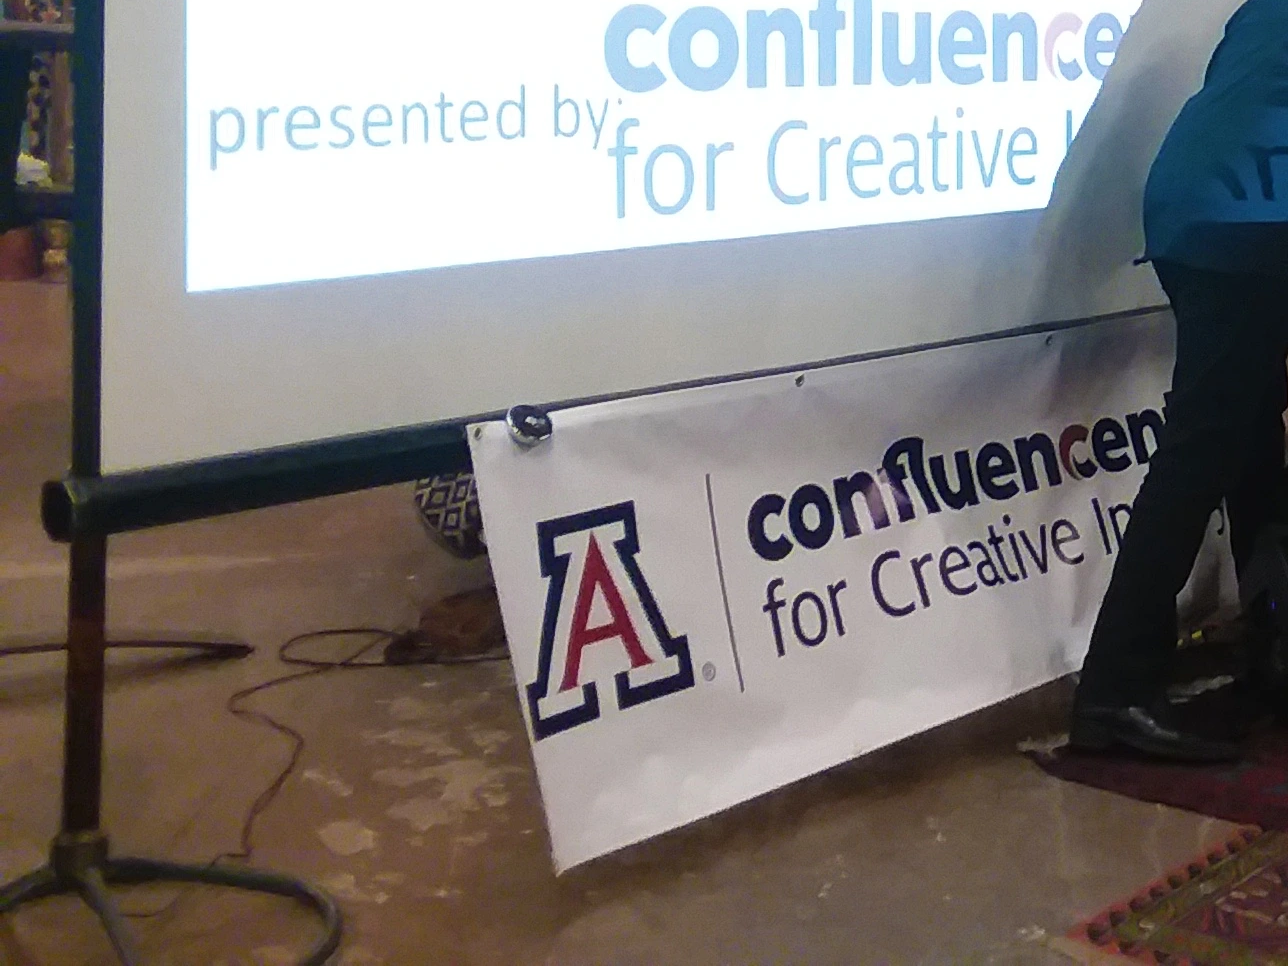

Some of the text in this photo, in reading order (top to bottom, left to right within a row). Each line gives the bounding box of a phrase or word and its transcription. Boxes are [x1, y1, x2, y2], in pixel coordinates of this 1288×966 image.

[209, 84, 526, 171] presented
[608, 118, 734, 219] for
[767, 107, 1037, 205] Creative
[526, 500, 695, 740] A
[763, 577, 847, 658] for
[871, 514, 1085, 617] Creative
